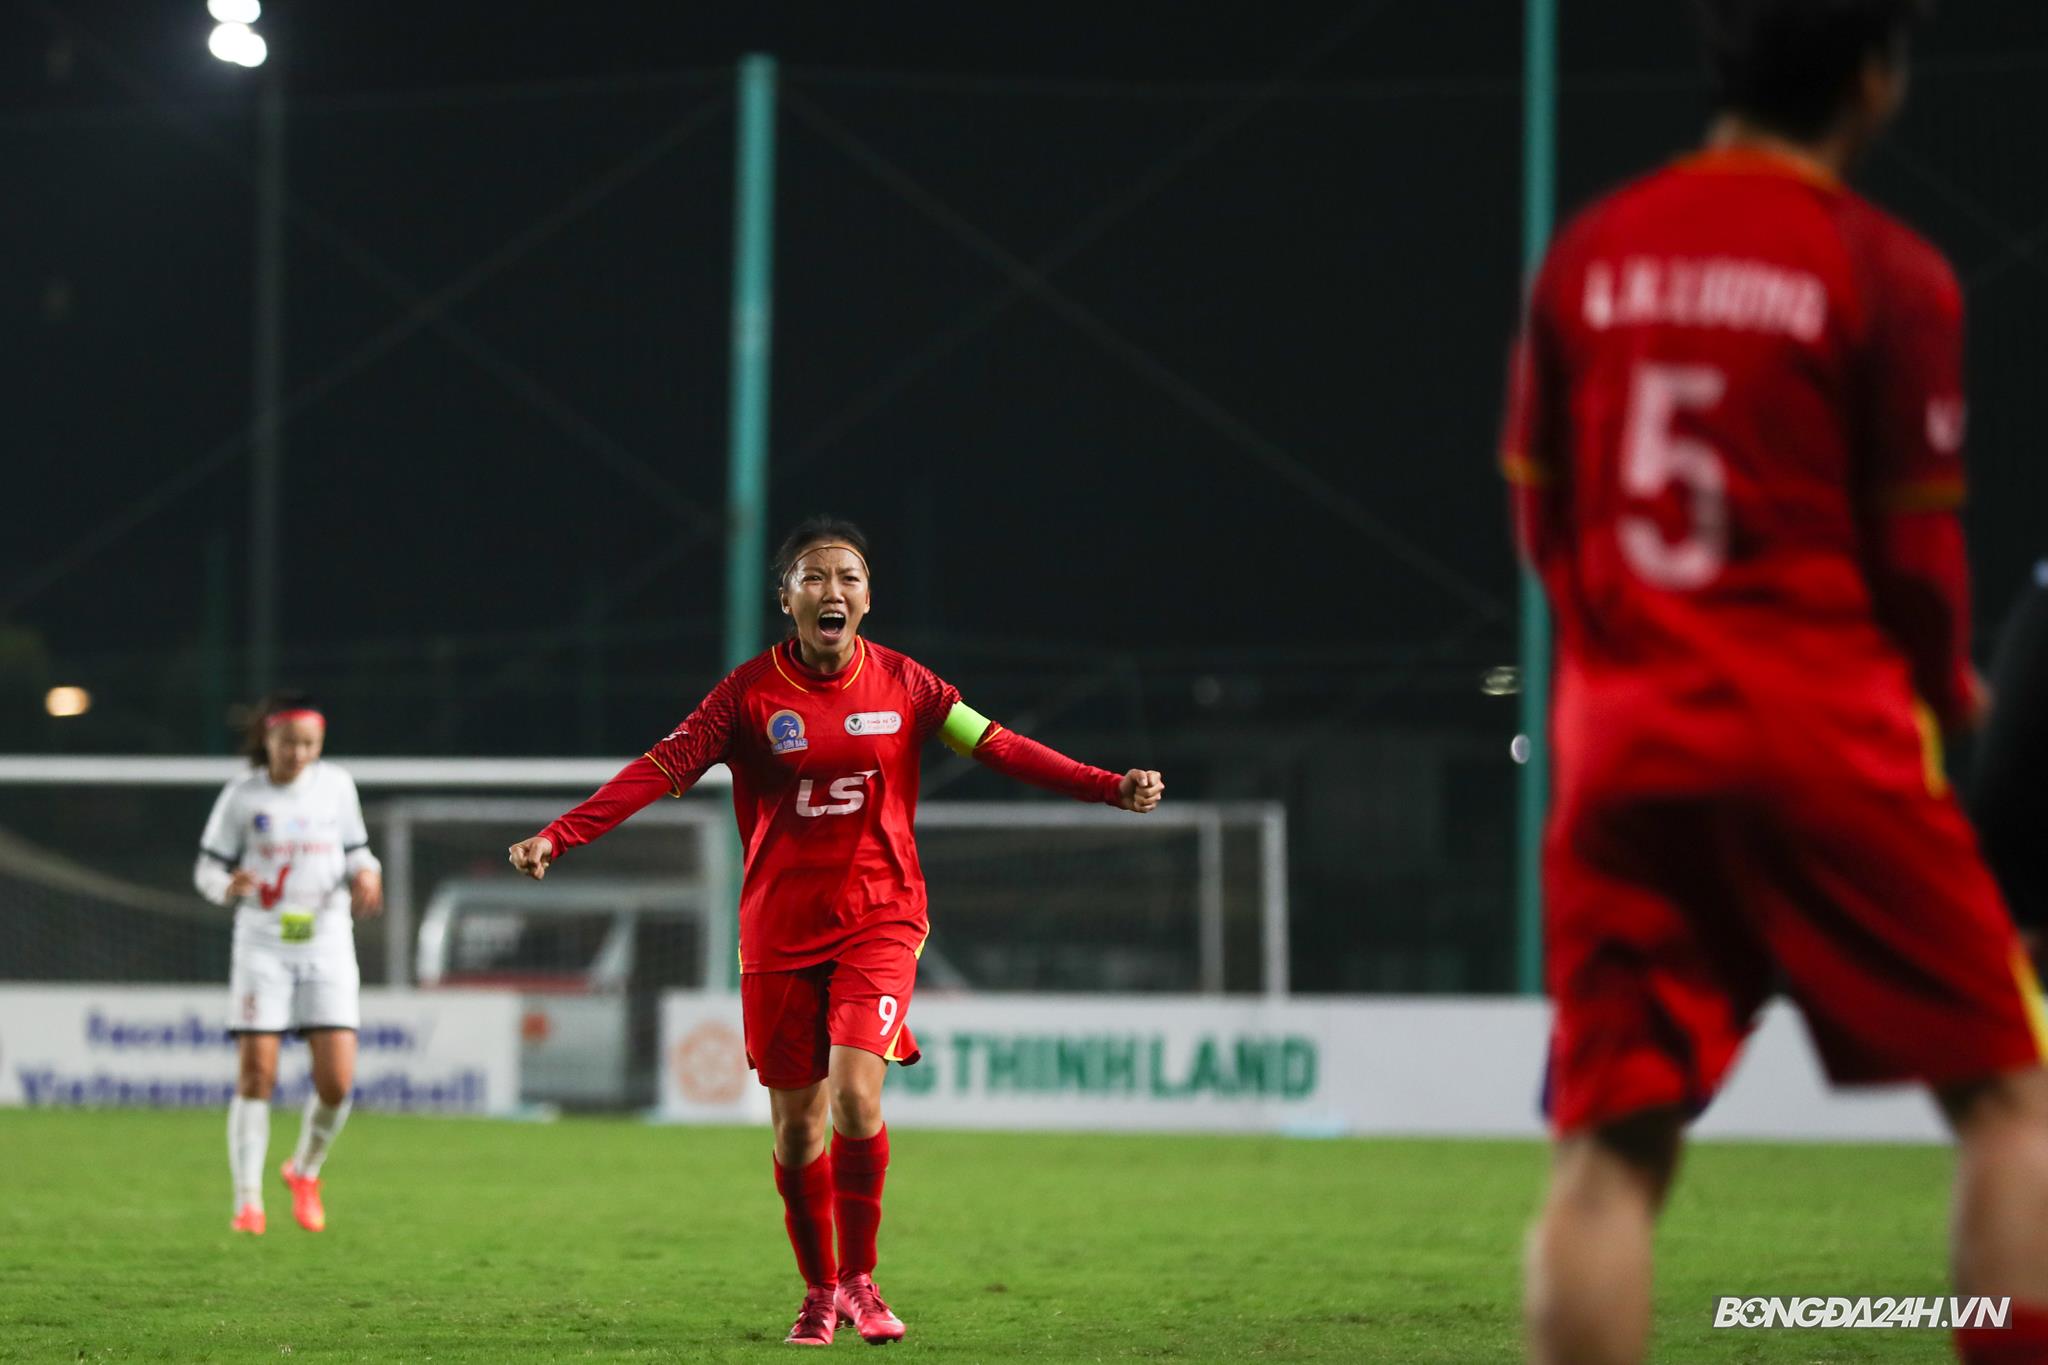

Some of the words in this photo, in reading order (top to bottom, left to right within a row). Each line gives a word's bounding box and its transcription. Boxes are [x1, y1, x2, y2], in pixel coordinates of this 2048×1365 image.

[1619, 358, 1727, 588] 5
[796, 776, 866, 817] LS
[878, 995, 898, 1036] 9
